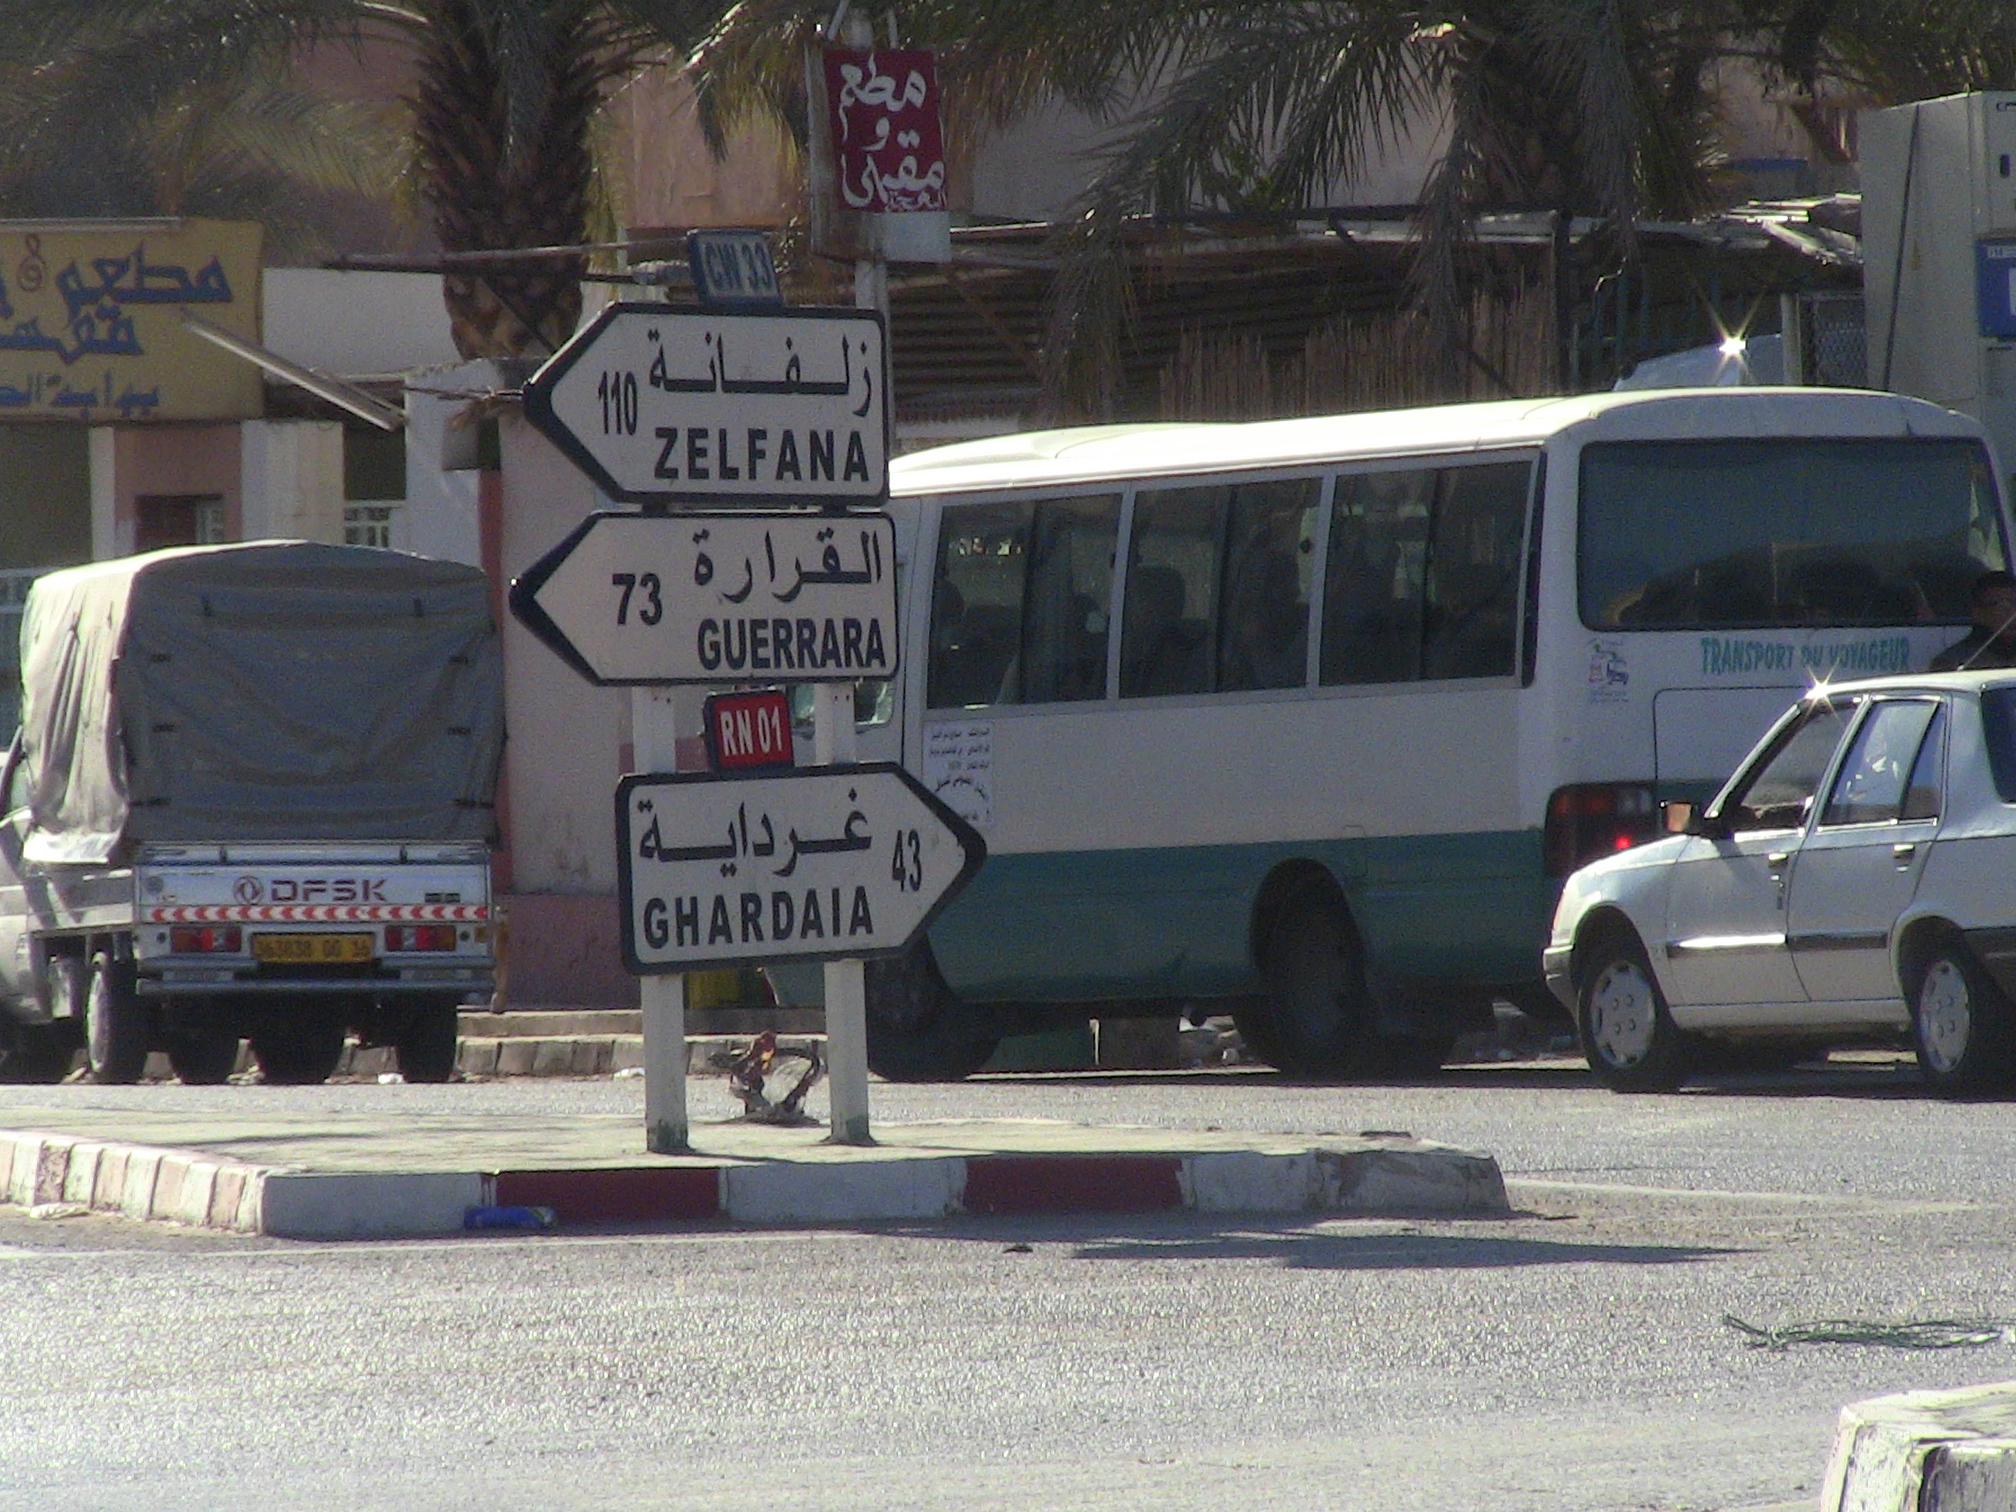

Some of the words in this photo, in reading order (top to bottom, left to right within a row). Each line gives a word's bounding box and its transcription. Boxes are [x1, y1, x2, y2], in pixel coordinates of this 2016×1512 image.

[838, 52, 927, 144] مطعم
[859, 117, 890, 151] و
[56, 240, 233, 327] مطعم
[597, 370, 638, 436] 110
[648, 328, 872, 418] زلفانة
[654, 427, 870, 482] ZELFANA
[692, 526, 881, 603] القرارة
[612, 572, 663, 626] 73
[698, 617, 887, 671] GUERRARA
[1700, 637, 1795, 677] TRANSPORT
[720, 708, 754, 757] RN
[757, 706, 783, 754] 01
[637, 787, 872, 878] غرداية
[892, 829, 922, 892] 43
[271, 879, 388, 902] DFSK
[643, 886, 875, 949] GHARDAIA
